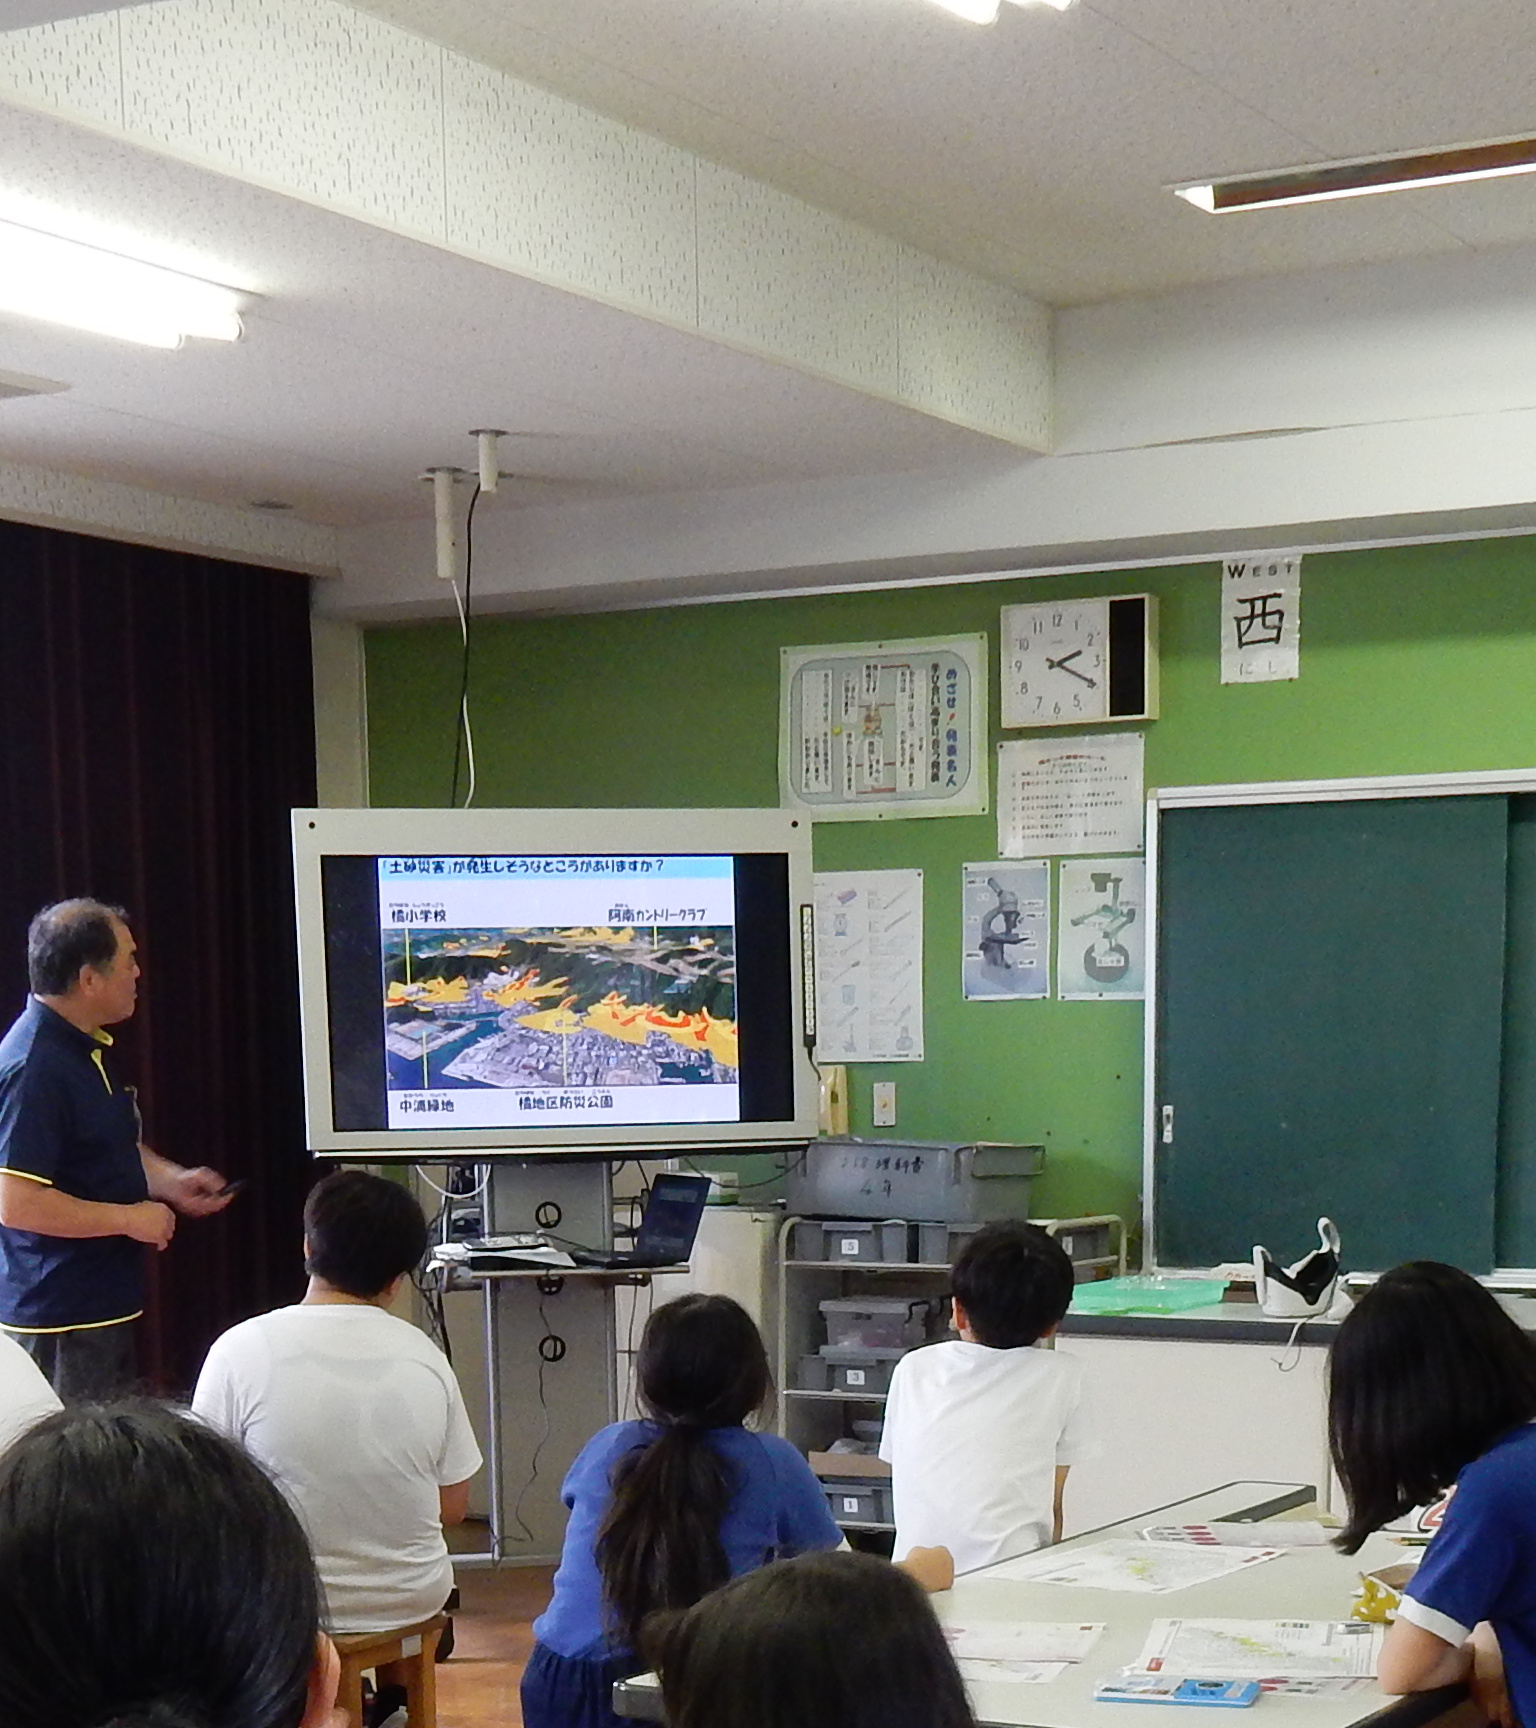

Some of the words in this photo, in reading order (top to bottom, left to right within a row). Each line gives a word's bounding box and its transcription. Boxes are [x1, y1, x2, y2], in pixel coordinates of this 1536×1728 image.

[1227, 563, 1293, 579] WEST
[1033, 621, 1043, 634] 11
[1052, 614, 1063, 627] 12
[1074, 620, 1079, 631] 1
[1233, 592, 1285, 649] 西
[1018, 638, 1030, 651] 10
[1086, 633, 1094, 647] 2
[1014, 660, 1022, 673] 9
[1093, 654, 1101, 668] 3
[1020, 681, 1029, 695] 8
[1036, 696, 1043, 710] 7
[1072, 694, 1081, 708] 5
[1053, 702, 1061, 715] 6
